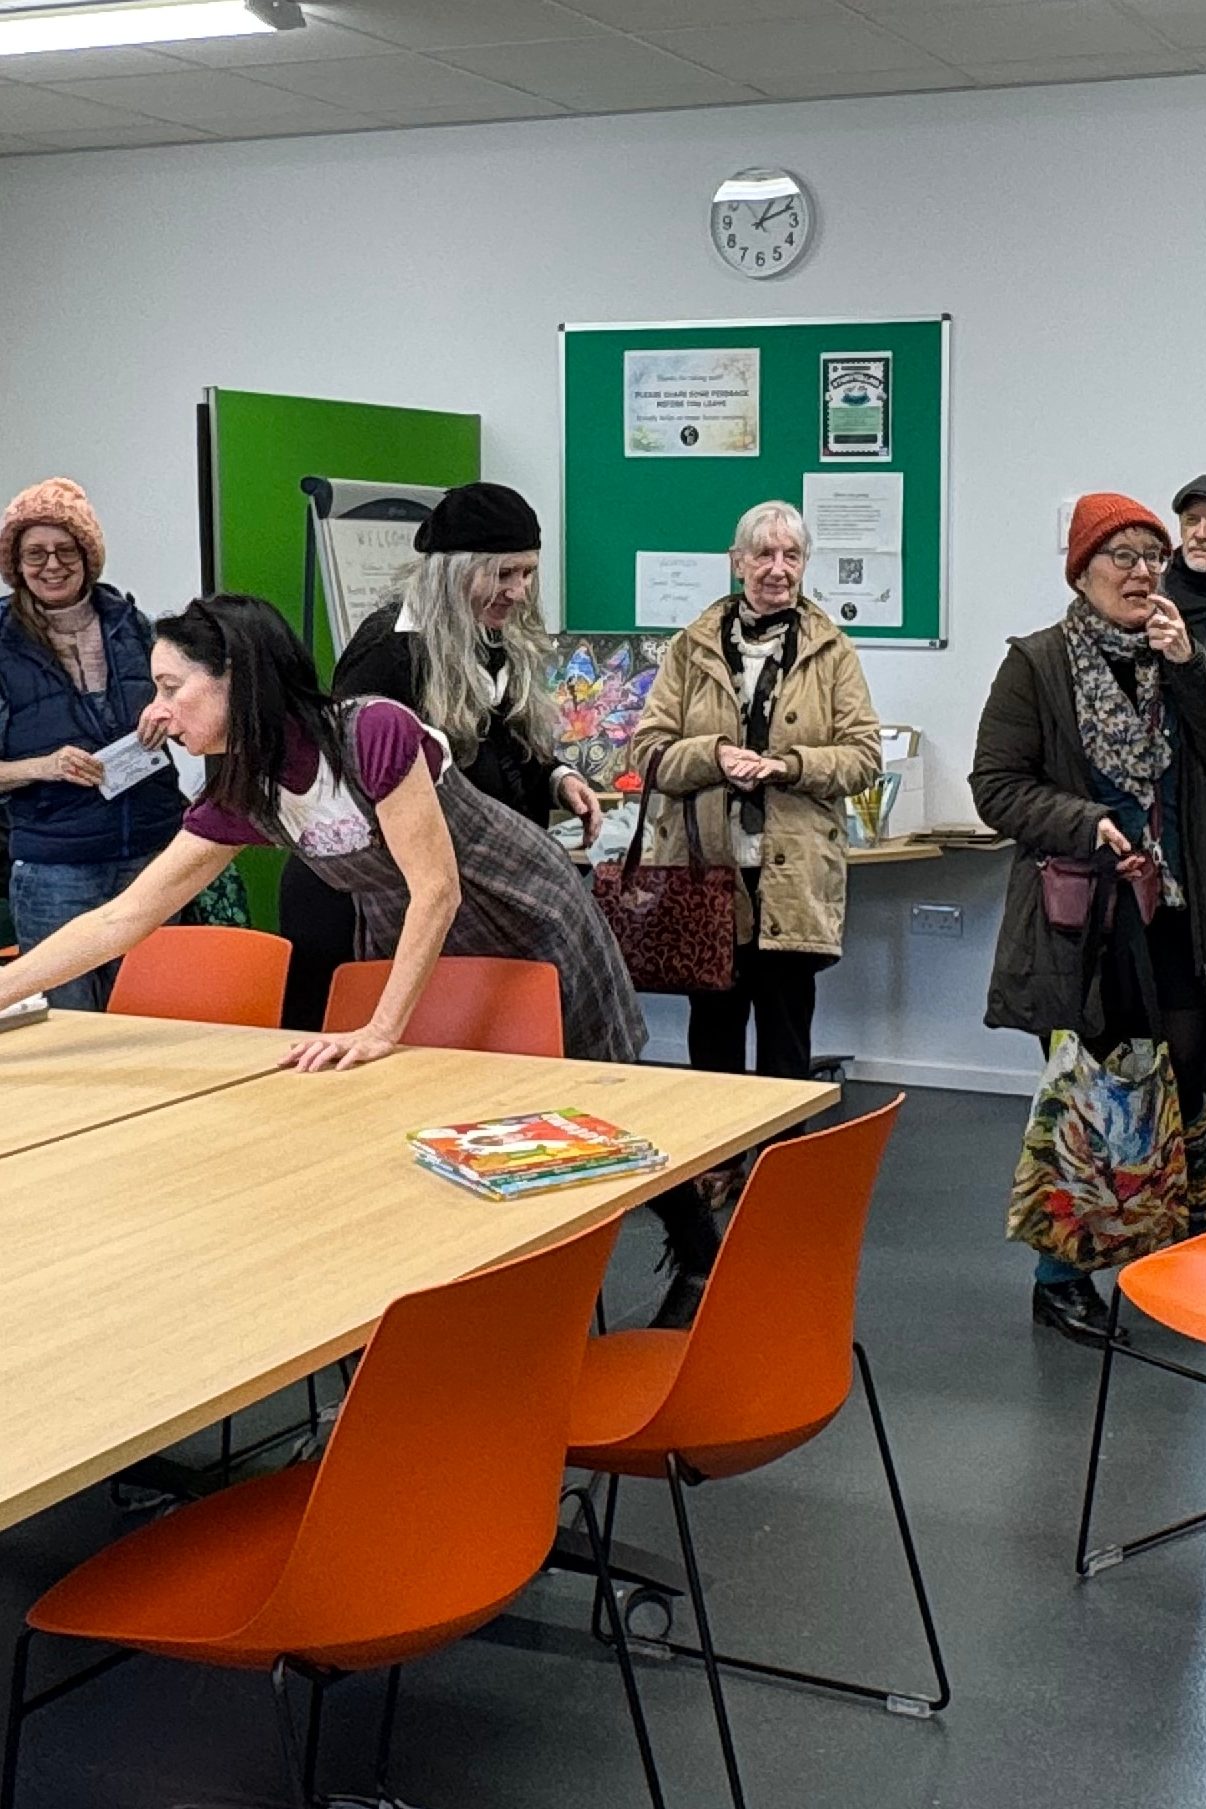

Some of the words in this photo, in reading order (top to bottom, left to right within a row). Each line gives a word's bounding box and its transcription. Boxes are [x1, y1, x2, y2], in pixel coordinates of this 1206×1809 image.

[723, 215, 733, 230] 9
[789, 212, 799, 228] 3
[727, 233, 737, 248] 8
[785, 232, 795, 246] 4
[739, 247, 749, 262] 7
[755, 252, 765, 267] 6
[773, 246, 782, 261] 5
